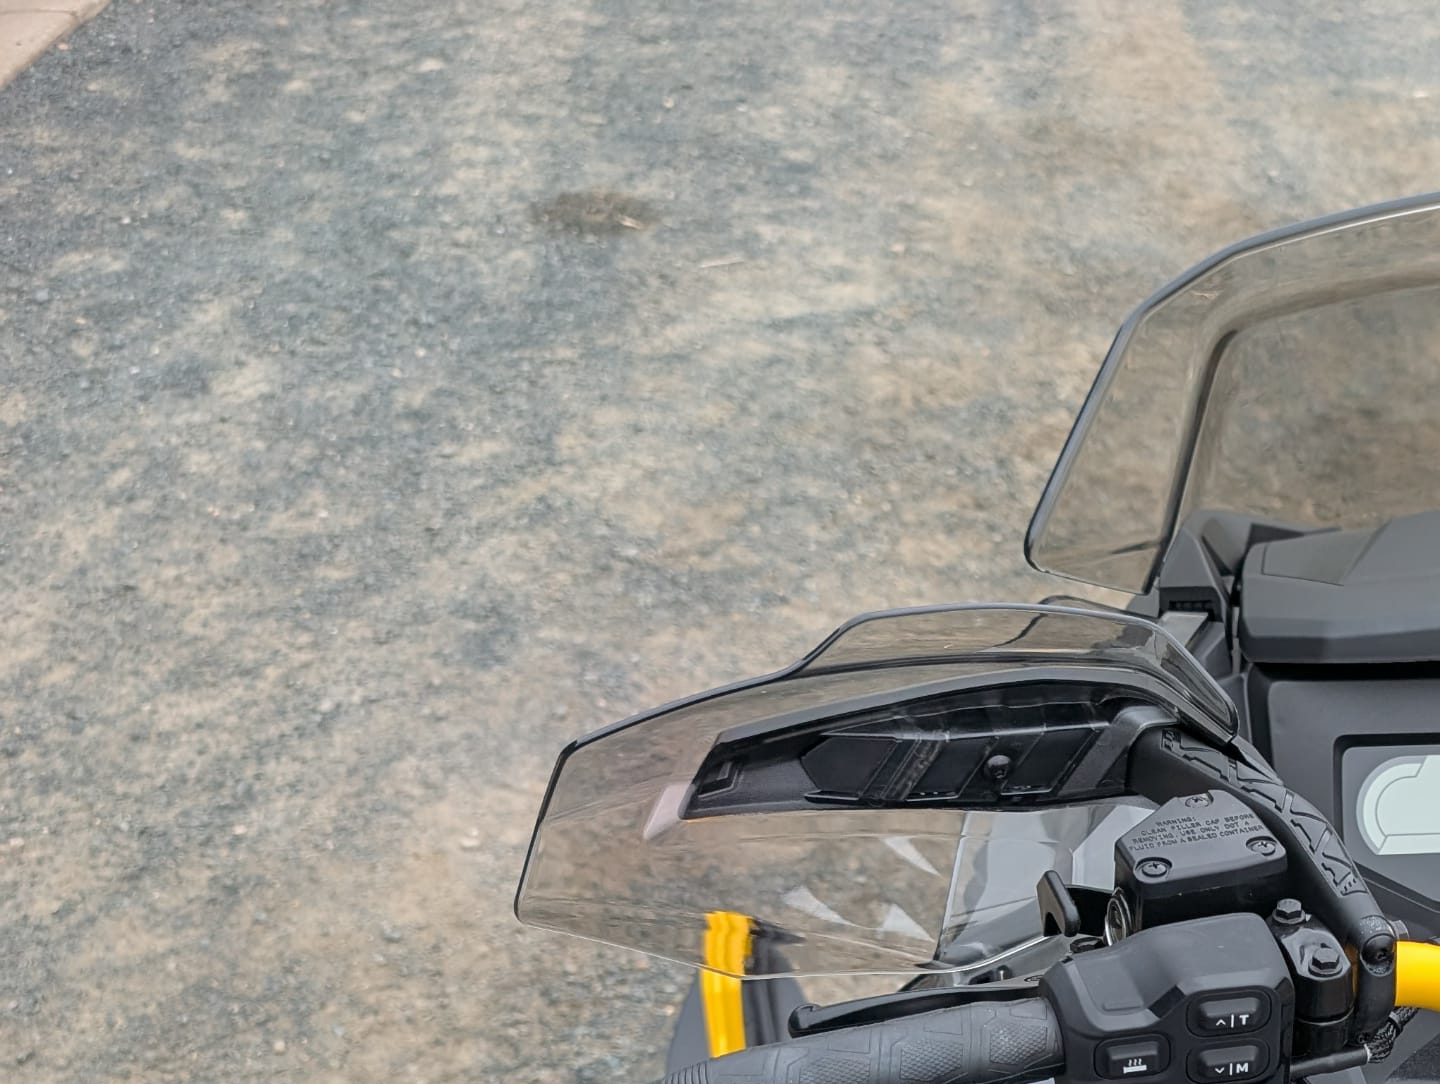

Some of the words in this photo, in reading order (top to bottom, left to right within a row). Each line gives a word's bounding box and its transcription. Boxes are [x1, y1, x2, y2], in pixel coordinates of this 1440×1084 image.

[1141, 827, 1167, 836] CLEAN
[1205, 818, 1220, 826] CAP
[1224, 813, 1255, 822] BEFORE
[1200, 825, 1219, 834] ONLY
[1157, 839, 1178, 847] FROM
[1187, 833, 1218, 842] SEALED
[1220, 825, 1264, 837] CONTAINER
[1239, 1015, 1249, 1026] T
[1236, 1064, 1249, 1073] M
